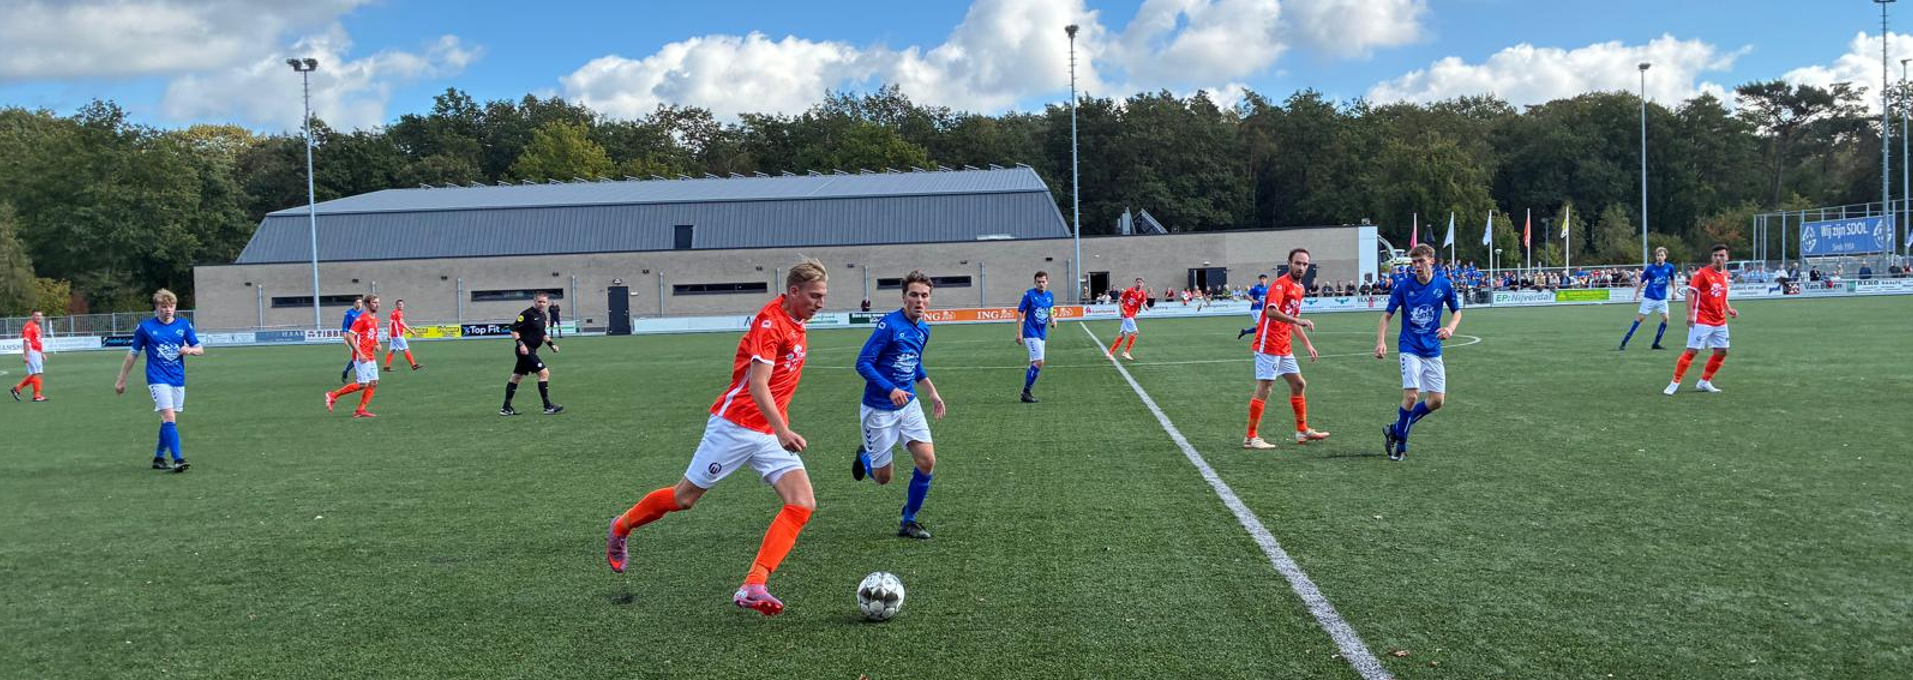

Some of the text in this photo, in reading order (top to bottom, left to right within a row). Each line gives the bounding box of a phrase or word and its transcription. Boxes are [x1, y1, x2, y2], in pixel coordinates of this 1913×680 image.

[1821, 221, 1869, 239] Wij zijn SDOL
[1804, 282, 1819, 290] Van
[977, 310, 999, 320] ING
[470, 325, 486, 335] Top
[487, 325, 500, 333] Fit
